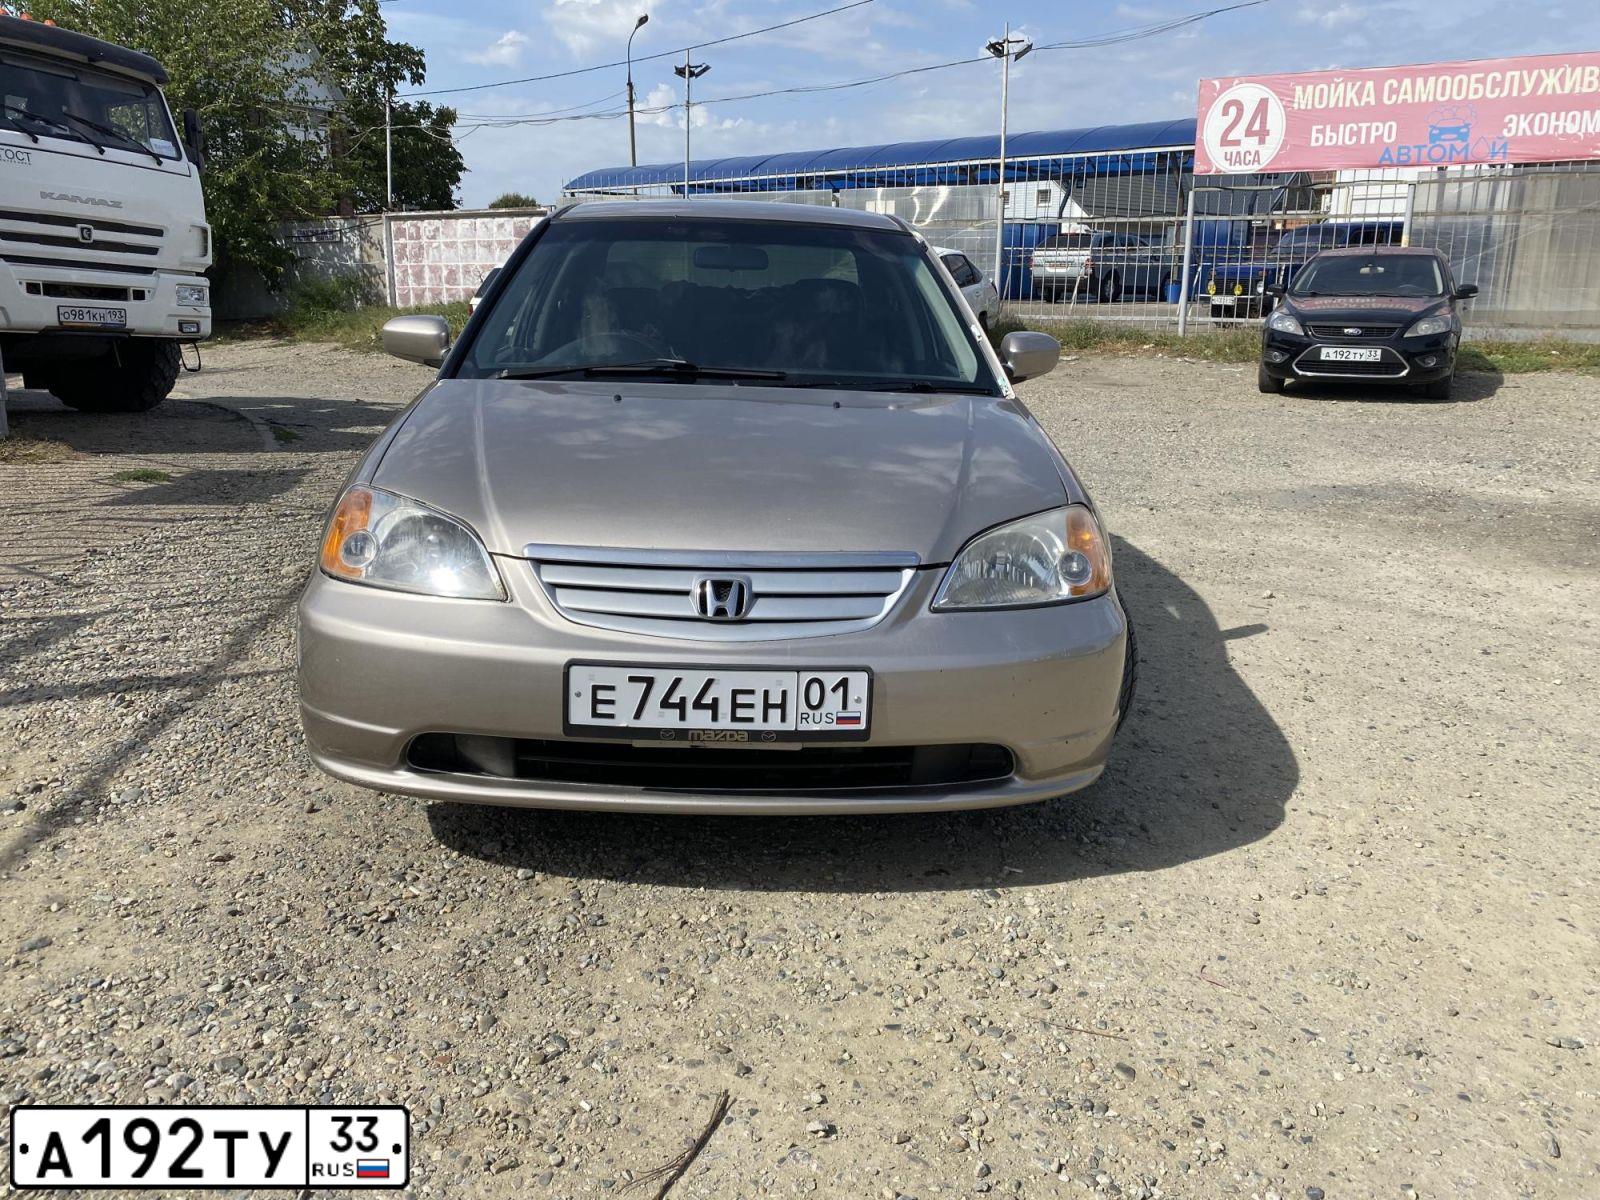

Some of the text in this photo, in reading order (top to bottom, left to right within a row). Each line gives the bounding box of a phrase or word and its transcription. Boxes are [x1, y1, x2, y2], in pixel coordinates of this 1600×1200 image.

[1294, 65, 1600, 110] МОЙКА САМООБСЛУЖИВ
[1220, 97, 1270, 148] 24
[1310, 121, 1397, 147] БЫСТРО
[1224, 150, 1261, 167] ЧАСА
[1367, 349, 1378, 358] 33
[591, 675, 849, 723] Е744ЕН 01
[800, 712, 834, 724] RUS
